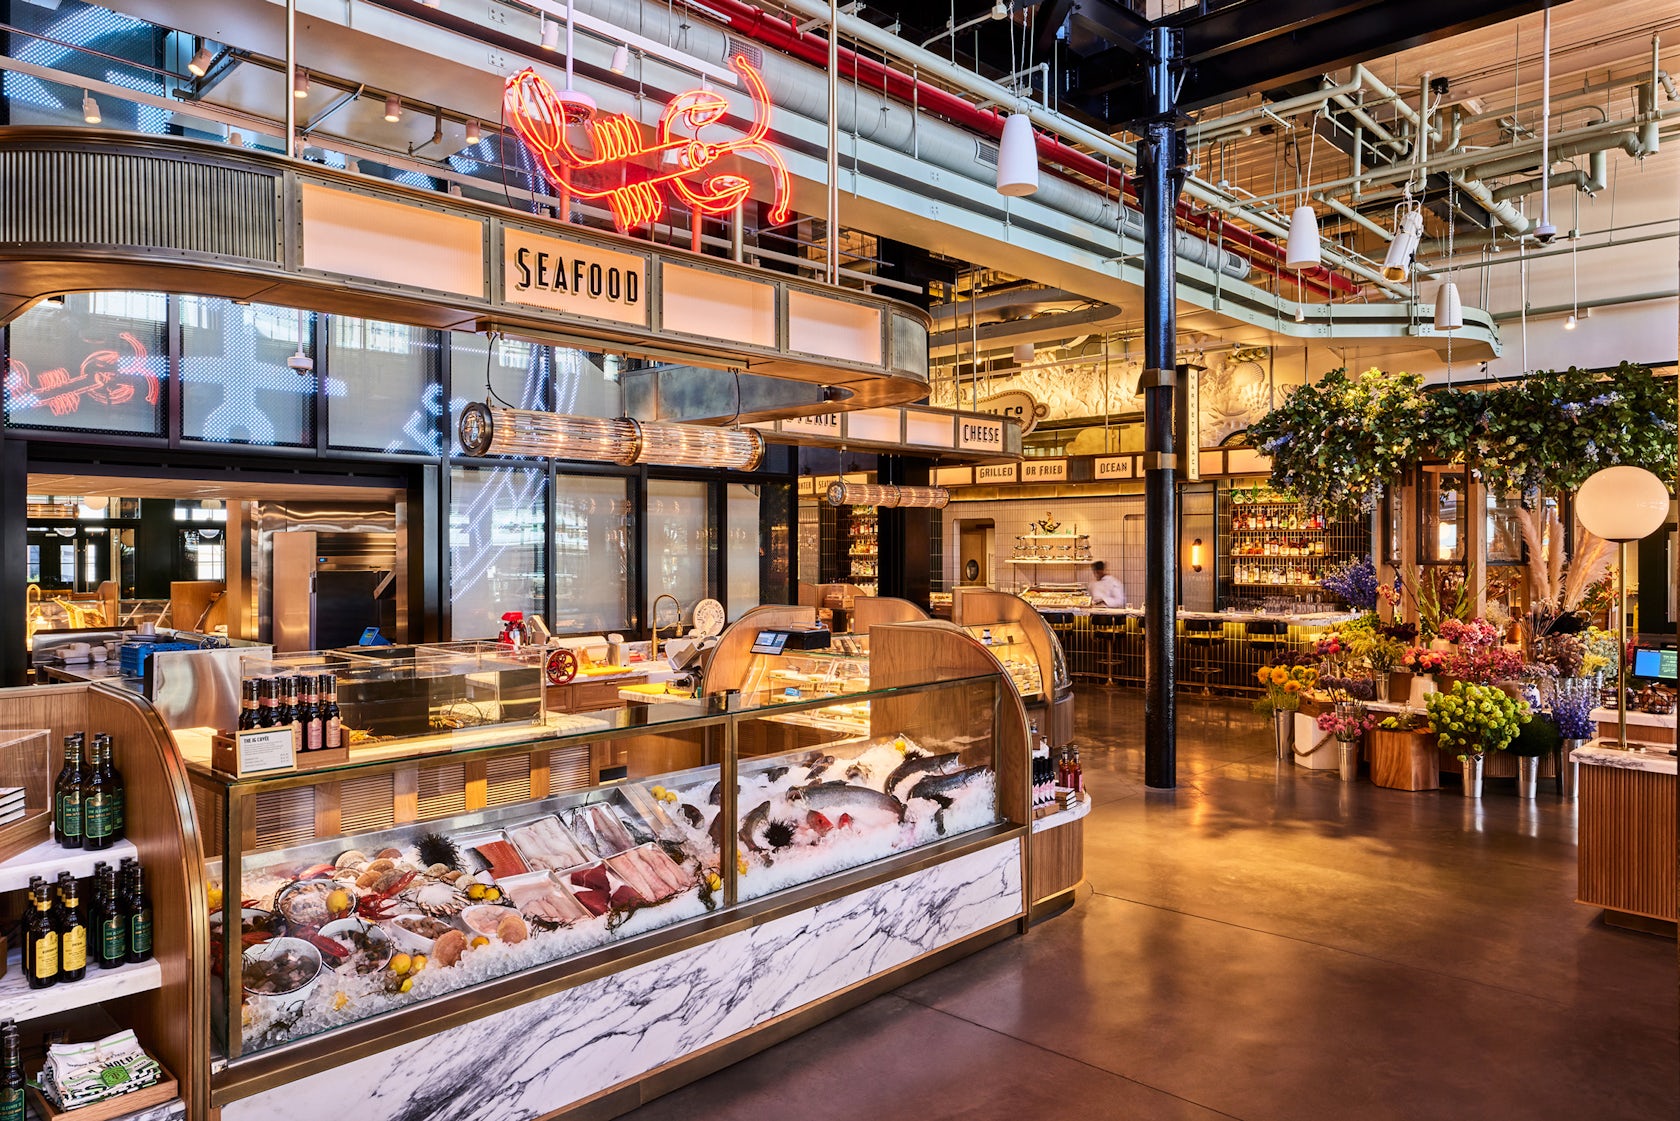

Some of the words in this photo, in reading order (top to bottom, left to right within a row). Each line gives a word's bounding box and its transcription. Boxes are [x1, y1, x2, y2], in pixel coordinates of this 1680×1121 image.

[515, 247, 638, 306] SEAFOOD
[963, 424, 1000, 443] CHEESE
[979, 467, 1013, 478] GRILLED
[1025, 466, 1036, 476] OR
[1039, 465, 1063, 476] FRIED
[1100, 462, 1127, 473] OCEAN
